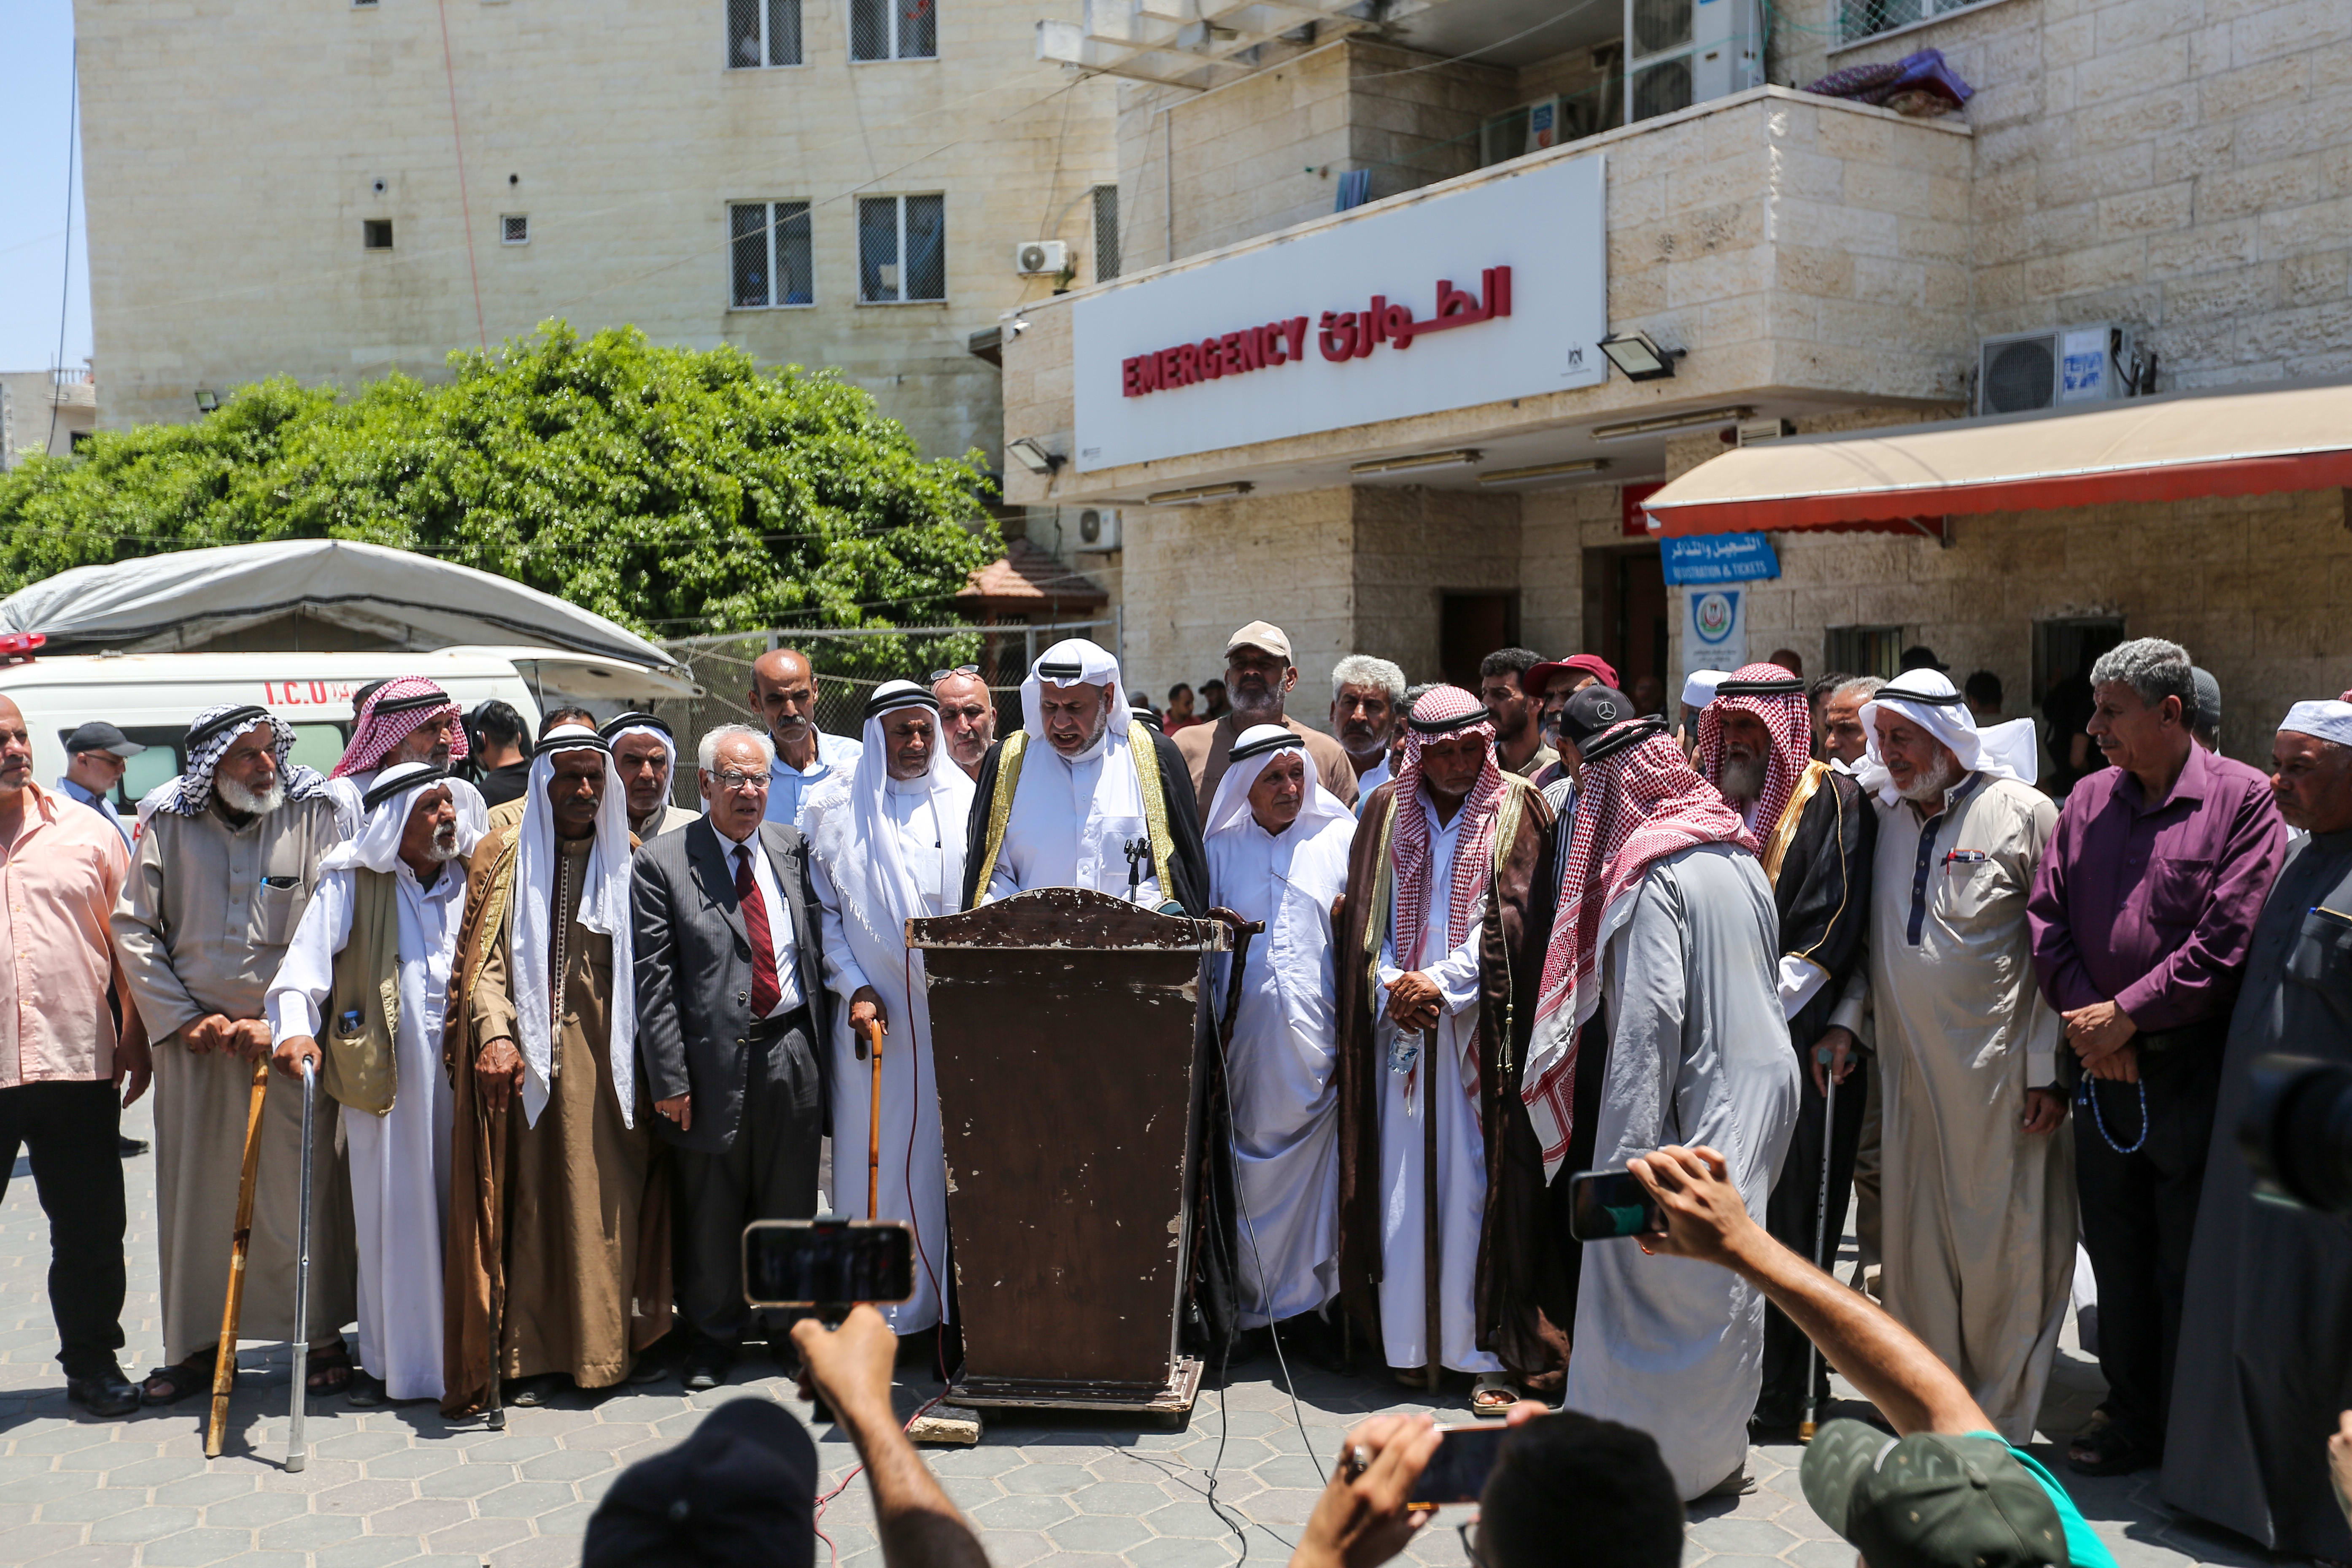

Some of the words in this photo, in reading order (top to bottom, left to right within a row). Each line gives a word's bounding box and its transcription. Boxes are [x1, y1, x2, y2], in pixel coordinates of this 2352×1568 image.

[1319, 265, 1511, 362] الطوارئ
[1122, 316, 1309, 397] EMERGENCY
[1723, 563, 1732, 578] &
[1732, 560, 1767, 575] TICKETS
[264, 681, 326, 704] I.C.U
